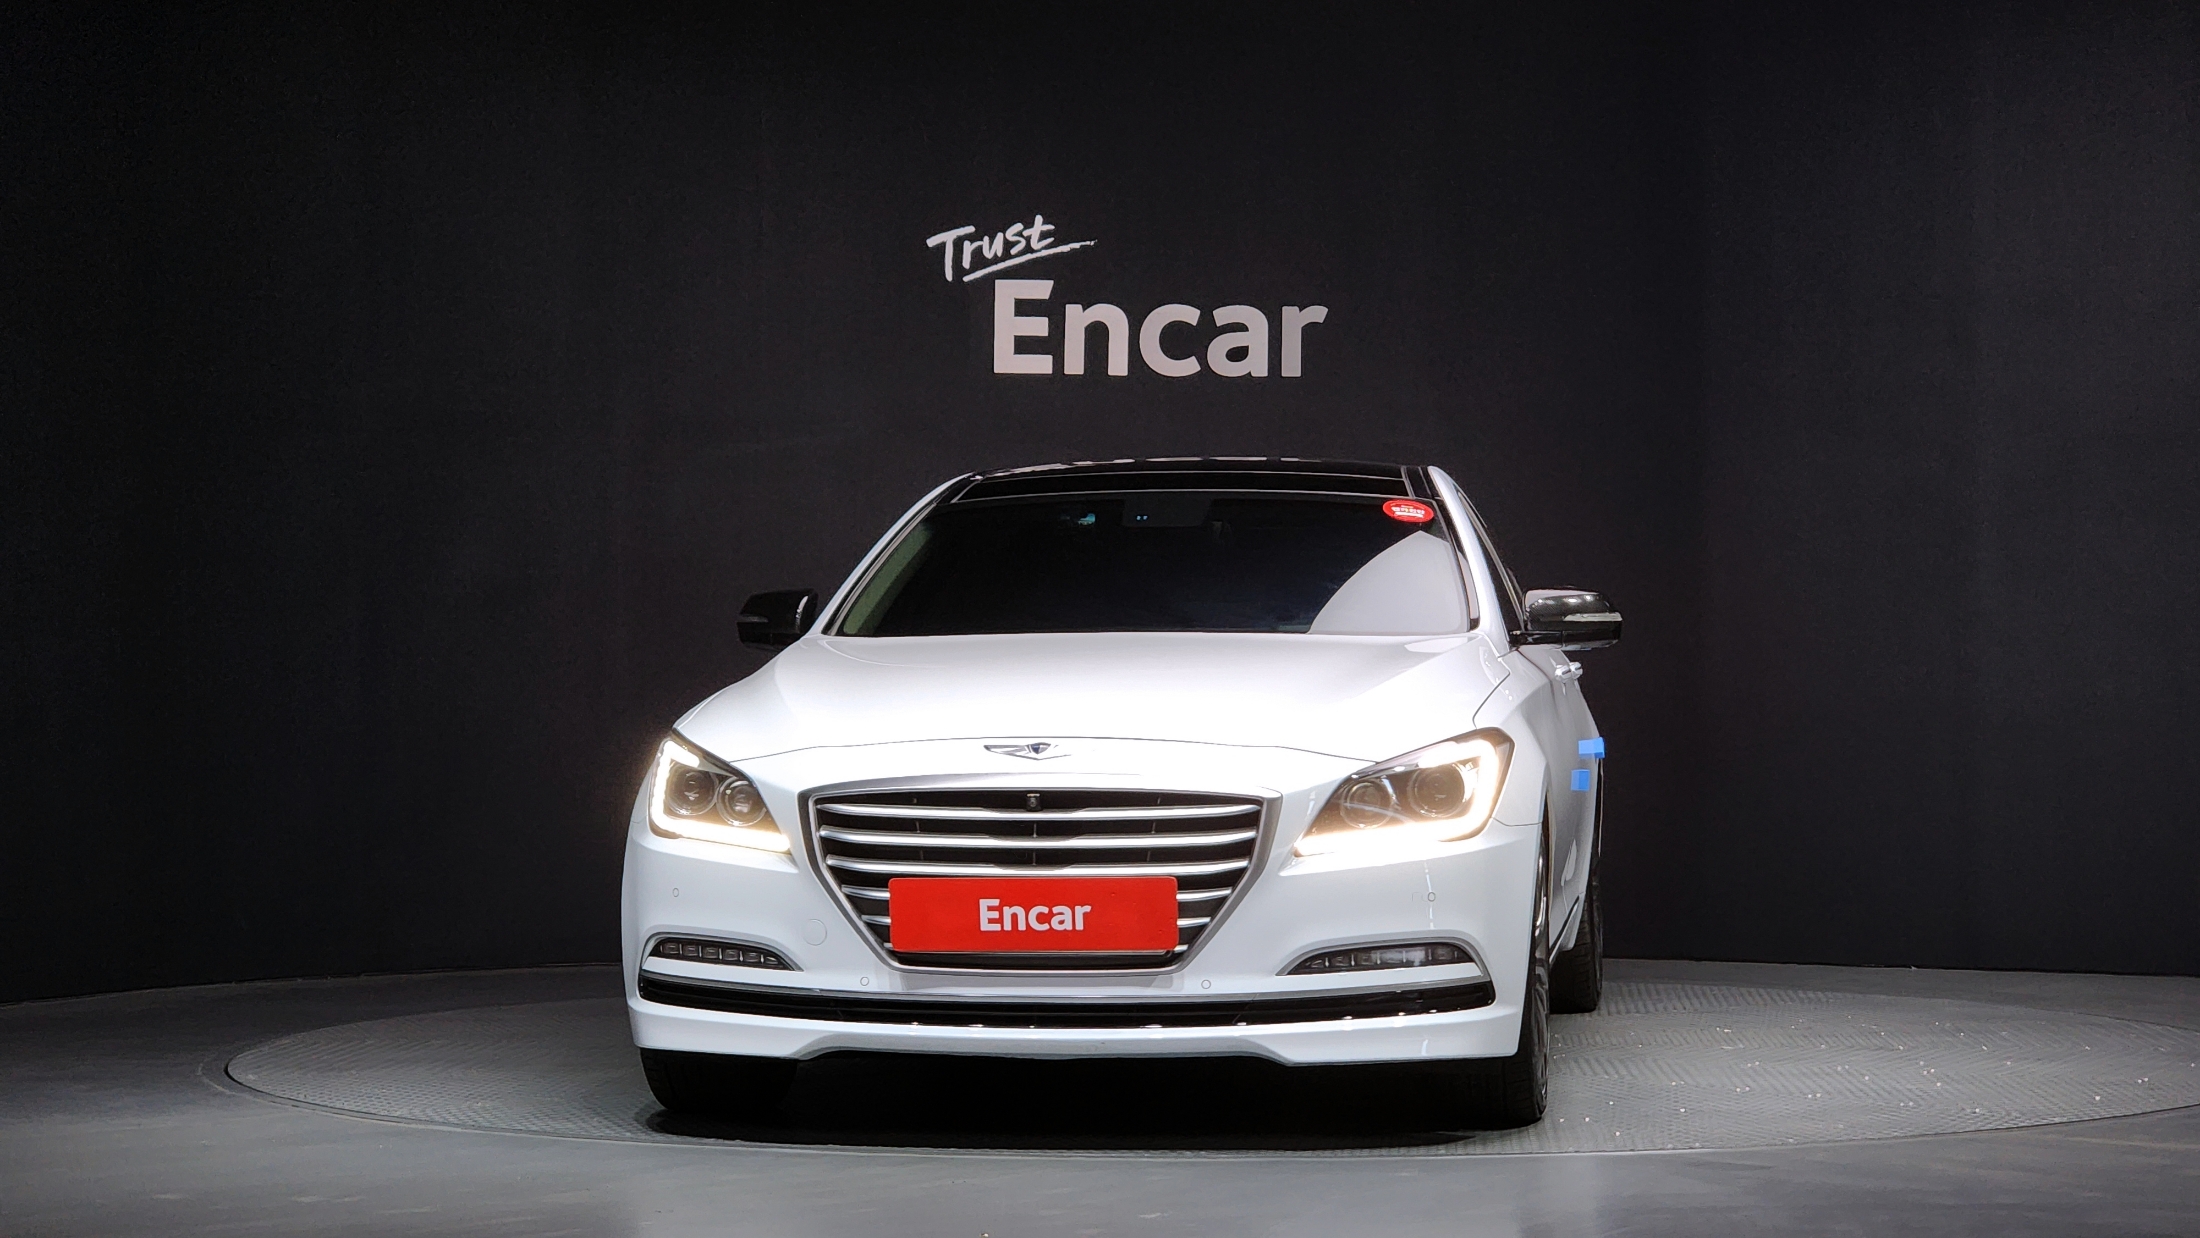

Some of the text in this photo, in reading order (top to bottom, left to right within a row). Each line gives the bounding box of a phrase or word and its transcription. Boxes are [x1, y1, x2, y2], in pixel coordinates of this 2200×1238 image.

[926, 214, 1057, 282] Trust
[993, 279, 1328, 377] Encar
[979, 898, 1092, 931] Encar
